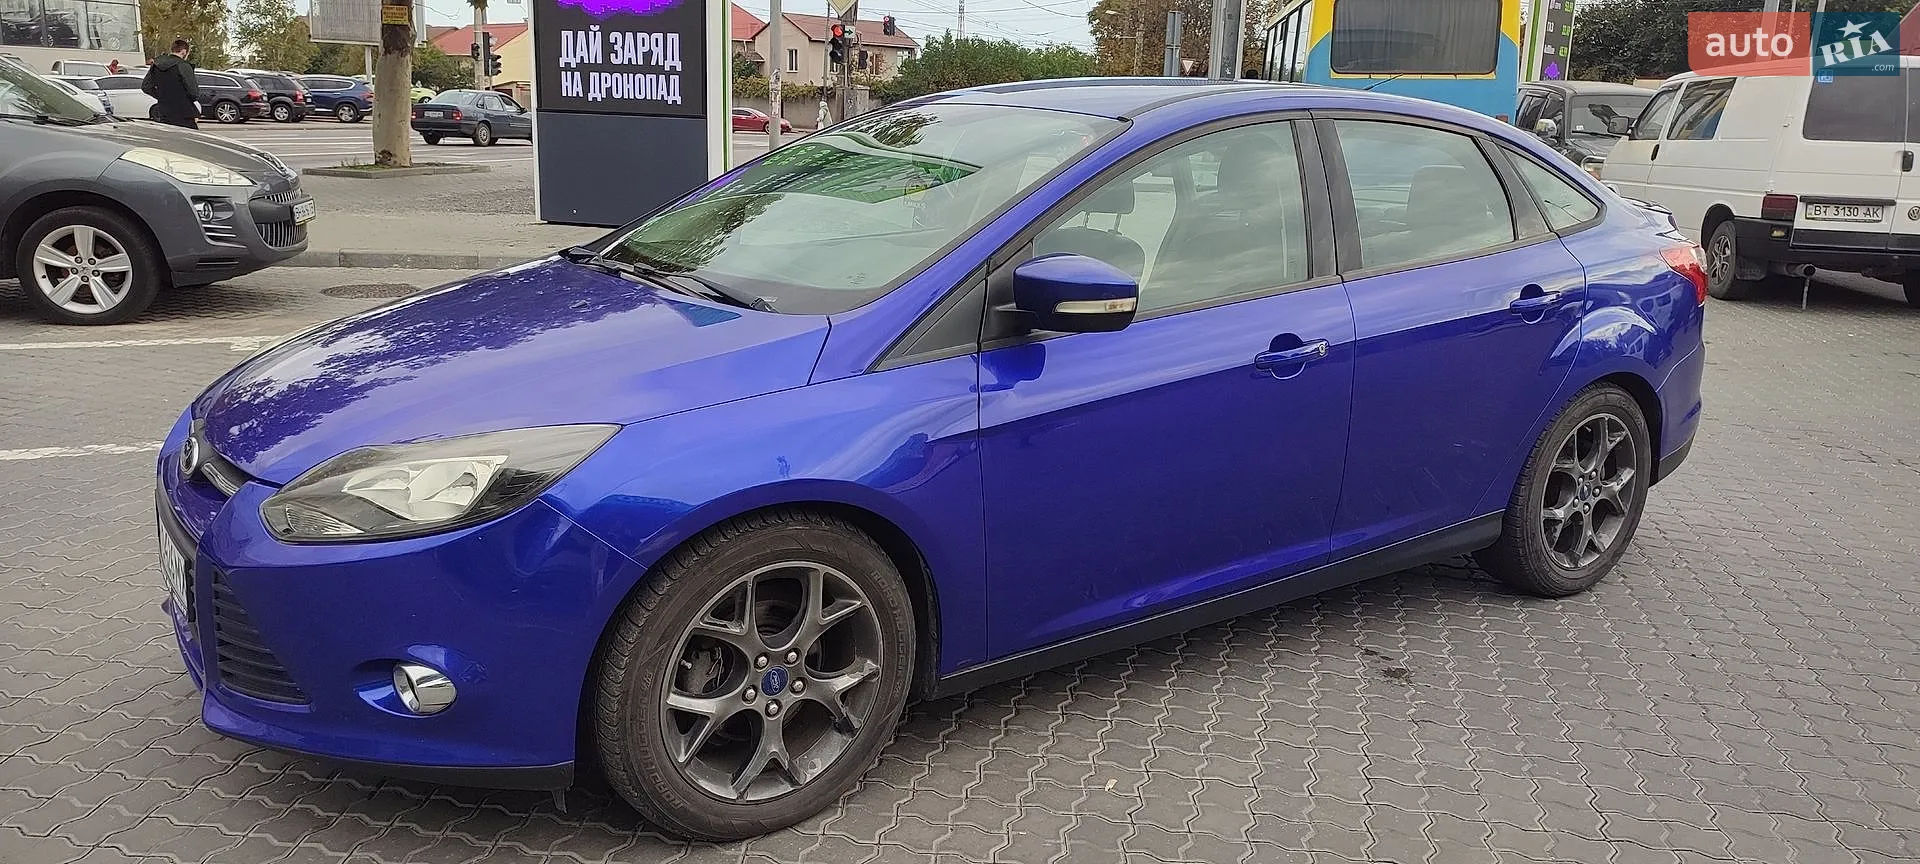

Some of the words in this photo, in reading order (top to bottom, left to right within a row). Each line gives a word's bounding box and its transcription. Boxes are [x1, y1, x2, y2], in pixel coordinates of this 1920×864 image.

[560, 25, 602, 67] ДАЙ
[609, 32, 681, 71] ЗАРЯД
[561, 71, 583, 97] НА
[588, 72, 681, 104] ДРОНОПАД
[1814, 205, 1830, 216] BT
[1833, 206, 1859, 217] 3130
[1863, 207, 1880, 218] AK
